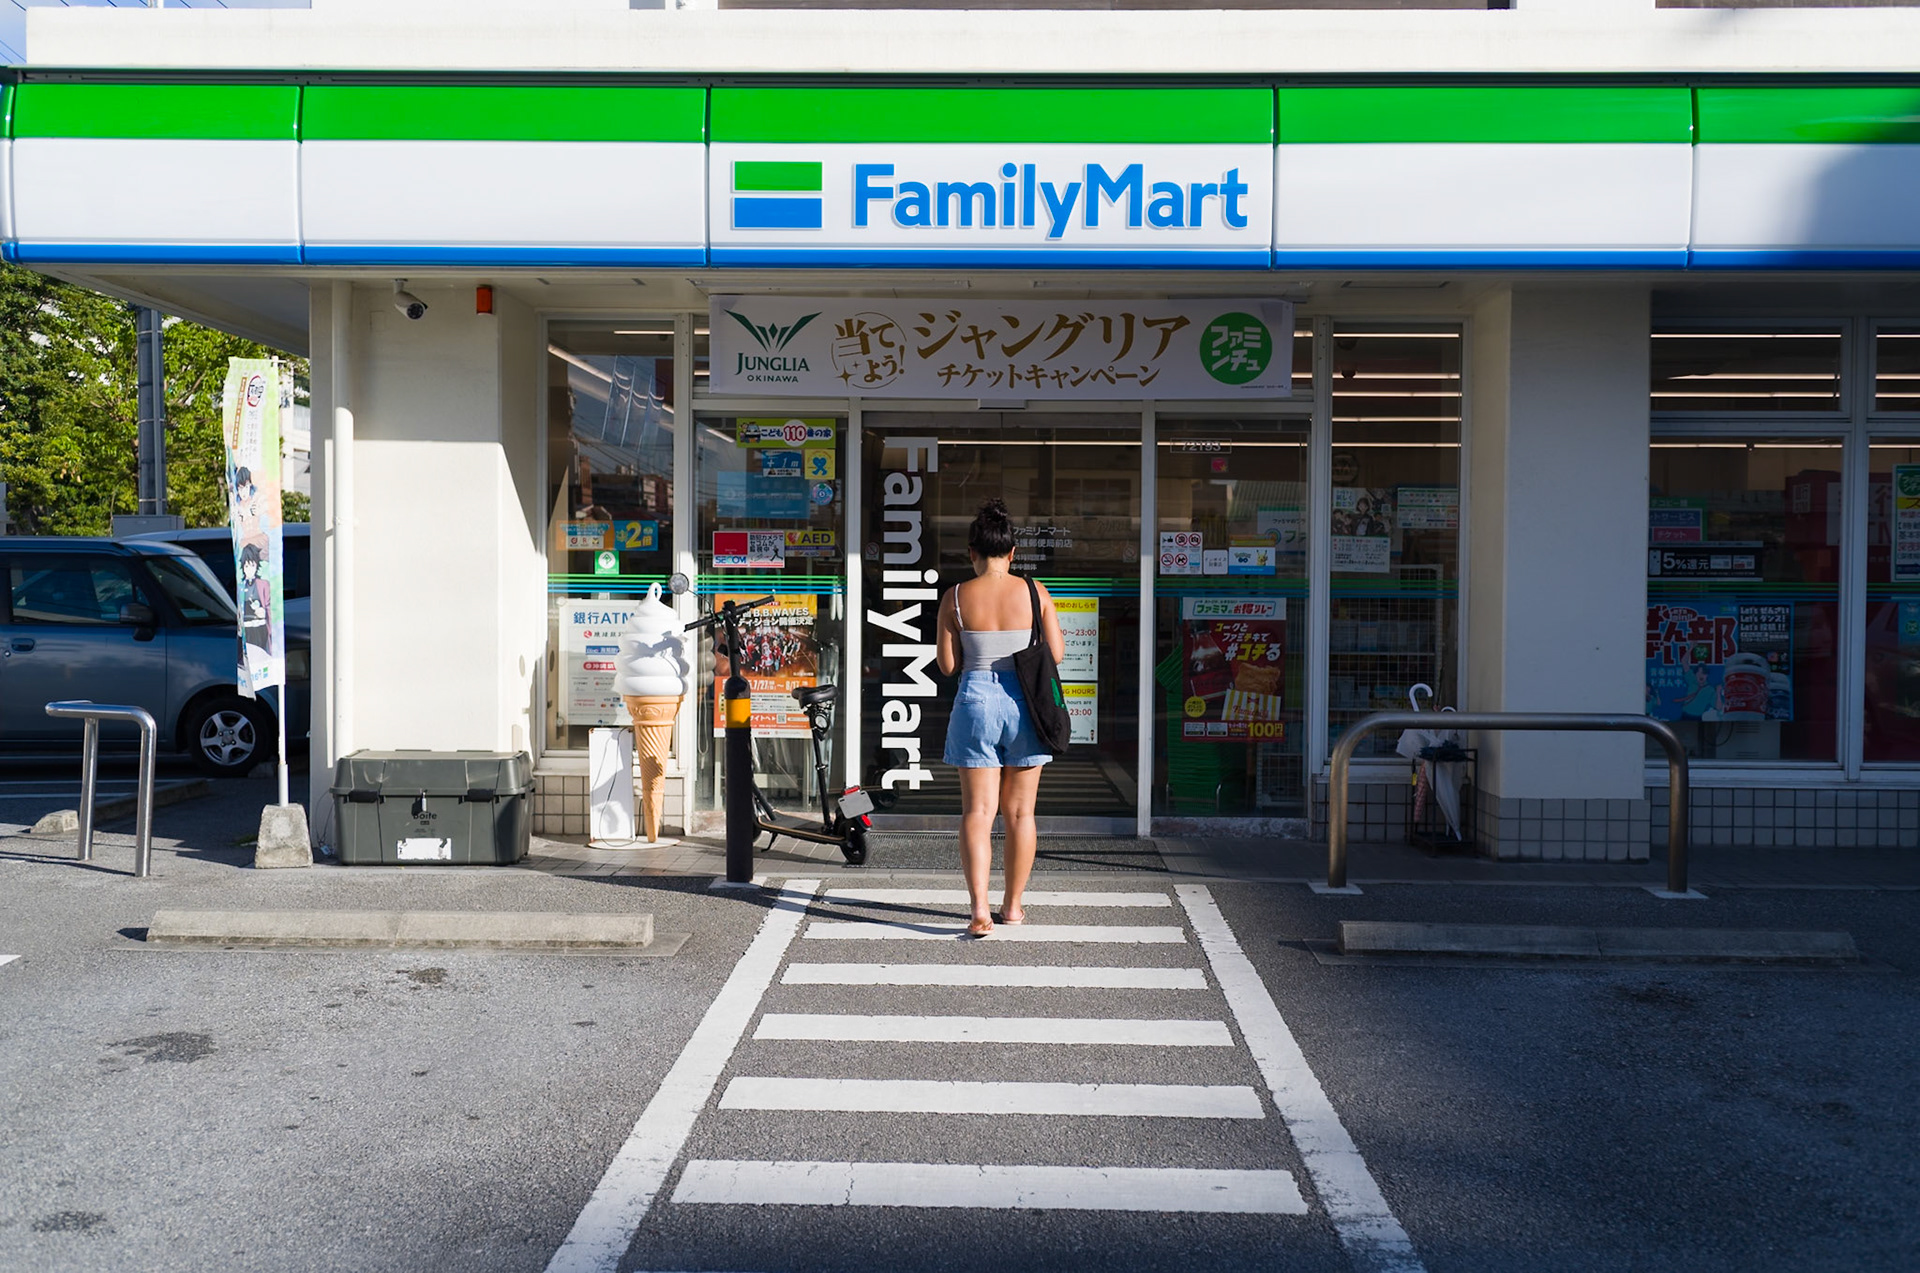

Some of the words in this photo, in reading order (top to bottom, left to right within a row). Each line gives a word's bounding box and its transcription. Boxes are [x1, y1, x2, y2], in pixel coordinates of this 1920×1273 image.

[853, 161, 1249, 239] FamilyMart
[832, 316, 897, 359] 当て
[912, 310, 1192, 362] ジャングリア
[1210, 325, 1263, 348] ファミ
[735, 352, 810, 375] JUNGLIA
[1211, 348, 1262, 371] ンチュ
[746, 374, 799, 383] OKINAWA
[936, 364, 1160, 389] チケットキャンペーン
[801, 533, 831, 544] AED
[715, 555, 747, 564] SECOM
[867, 436, 940, 791] FamilyMart
[1224, 643, 1281, 662] #コチる
[1069, 708, 1092, 716] 23:00
